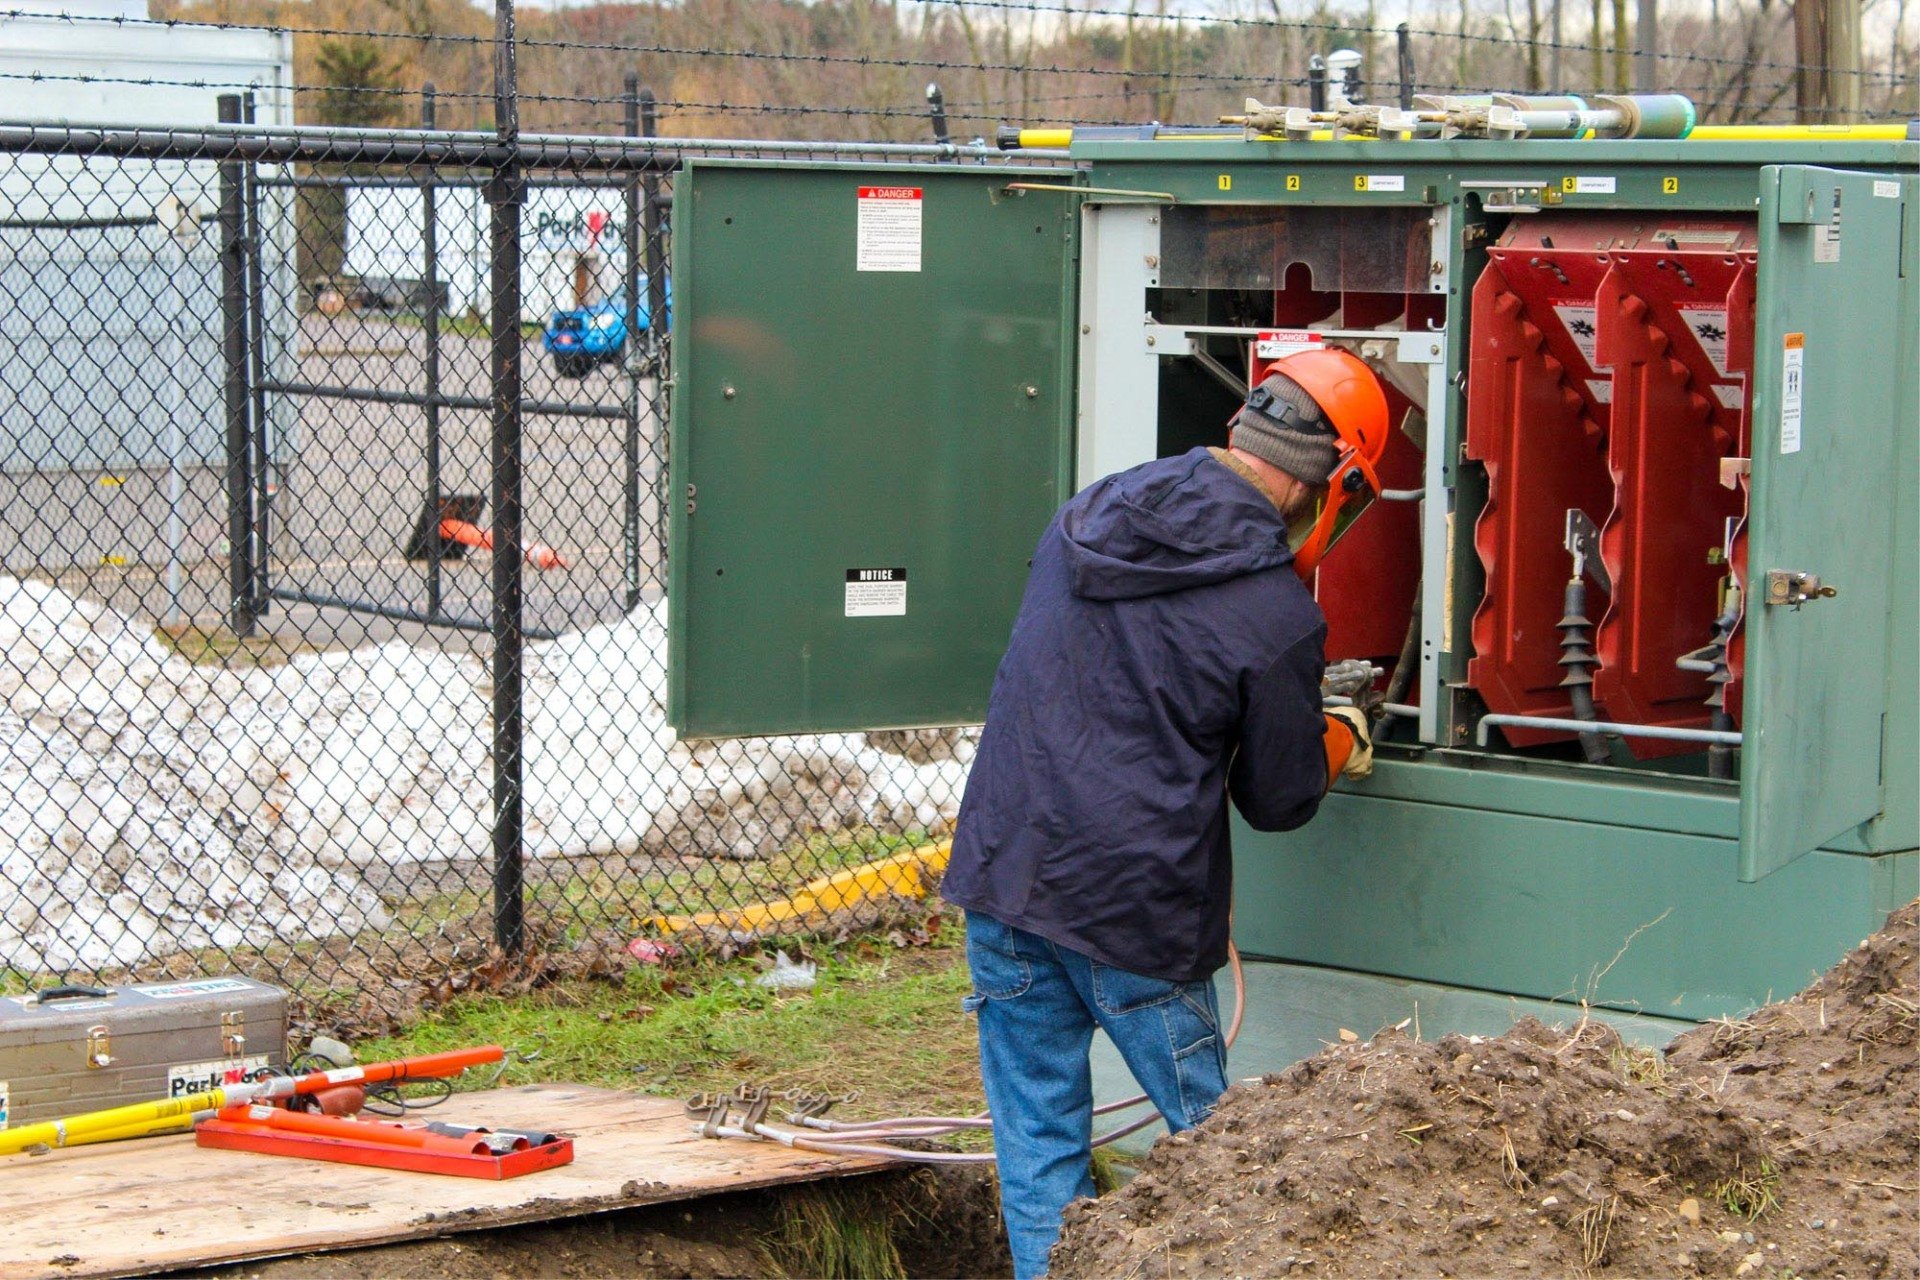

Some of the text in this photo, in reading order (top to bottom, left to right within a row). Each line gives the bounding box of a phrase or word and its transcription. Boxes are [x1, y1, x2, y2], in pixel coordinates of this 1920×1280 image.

[1290, 177, 1297, 188] 2
[1358, 176, 1365, 188] 3
[1566, 178, 1574, 190] 3
[1667, 179, 1675, 190] 2
[878, 189, 914, 198] DANGER
[1279, 333, 1309, 342] DANGER
[860, 569, 893, 581] NOTICE
